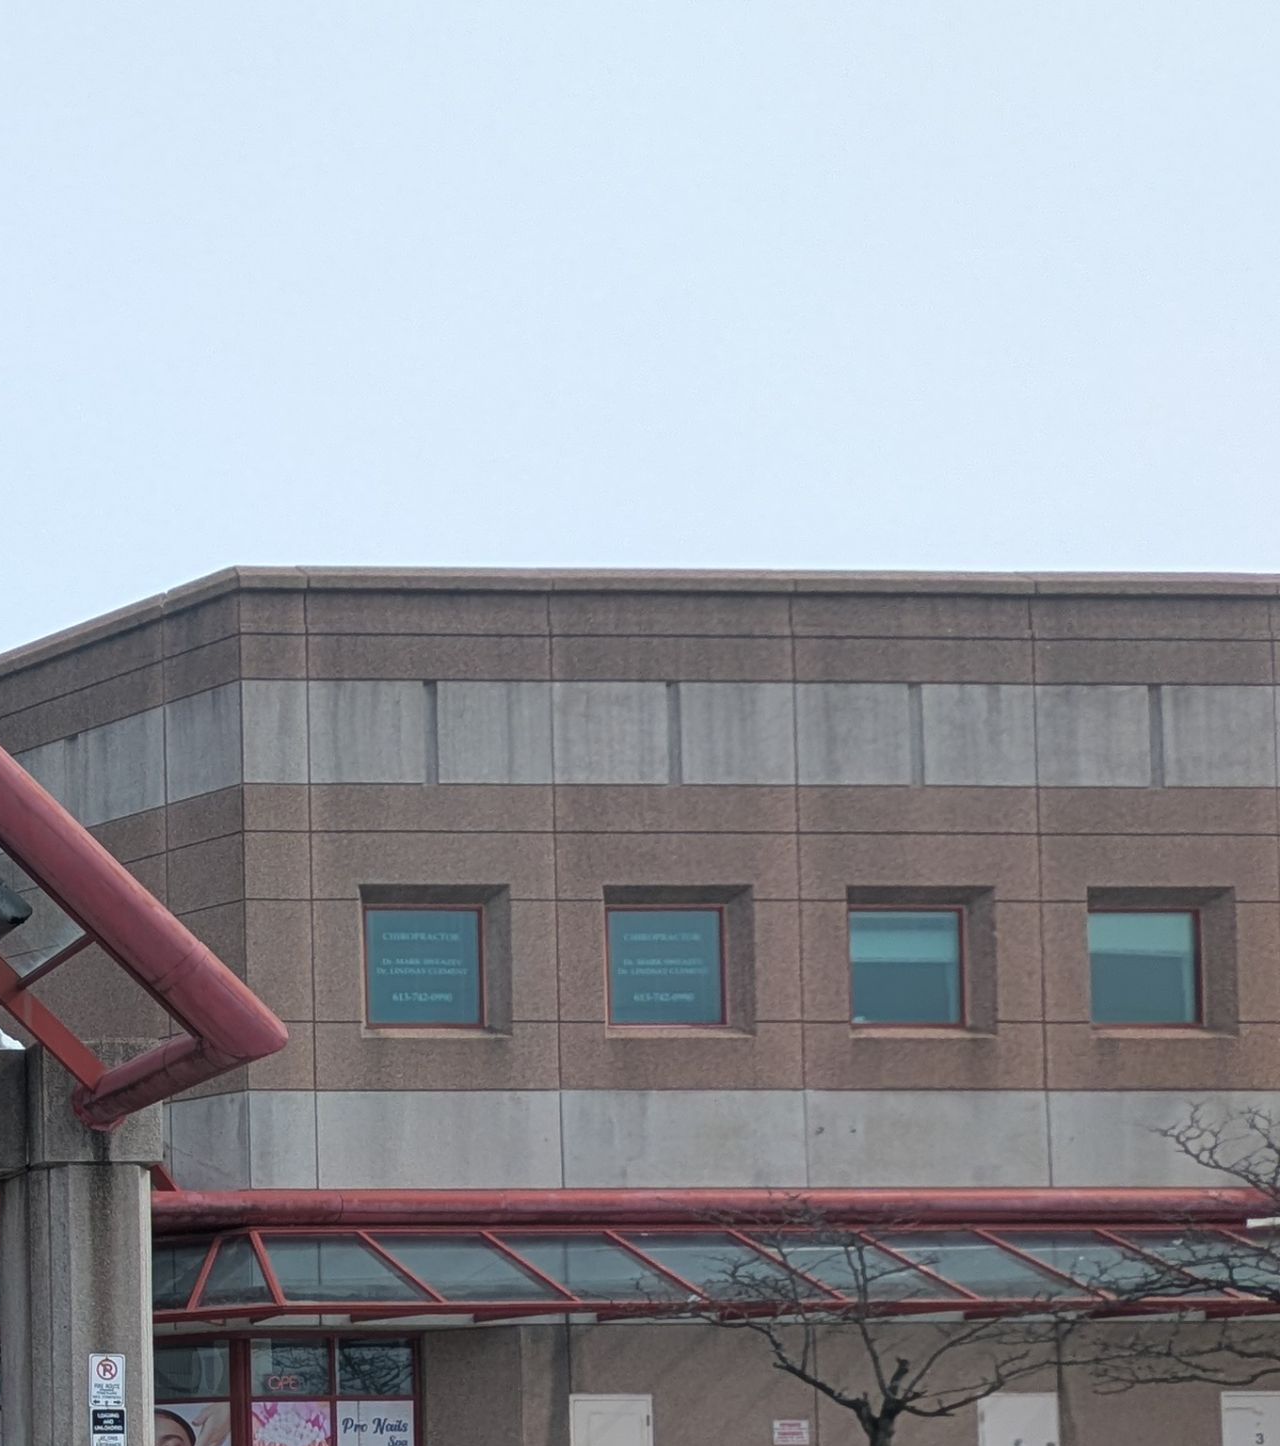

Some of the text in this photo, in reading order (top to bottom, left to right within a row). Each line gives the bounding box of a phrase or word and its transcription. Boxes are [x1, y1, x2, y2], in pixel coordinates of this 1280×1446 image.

[382, 932, 459, 941] CHIROPRACTOR
[342, 1417, 409, 1435] Pro Nails
[1255, 1432, 1264, 1445] 3
